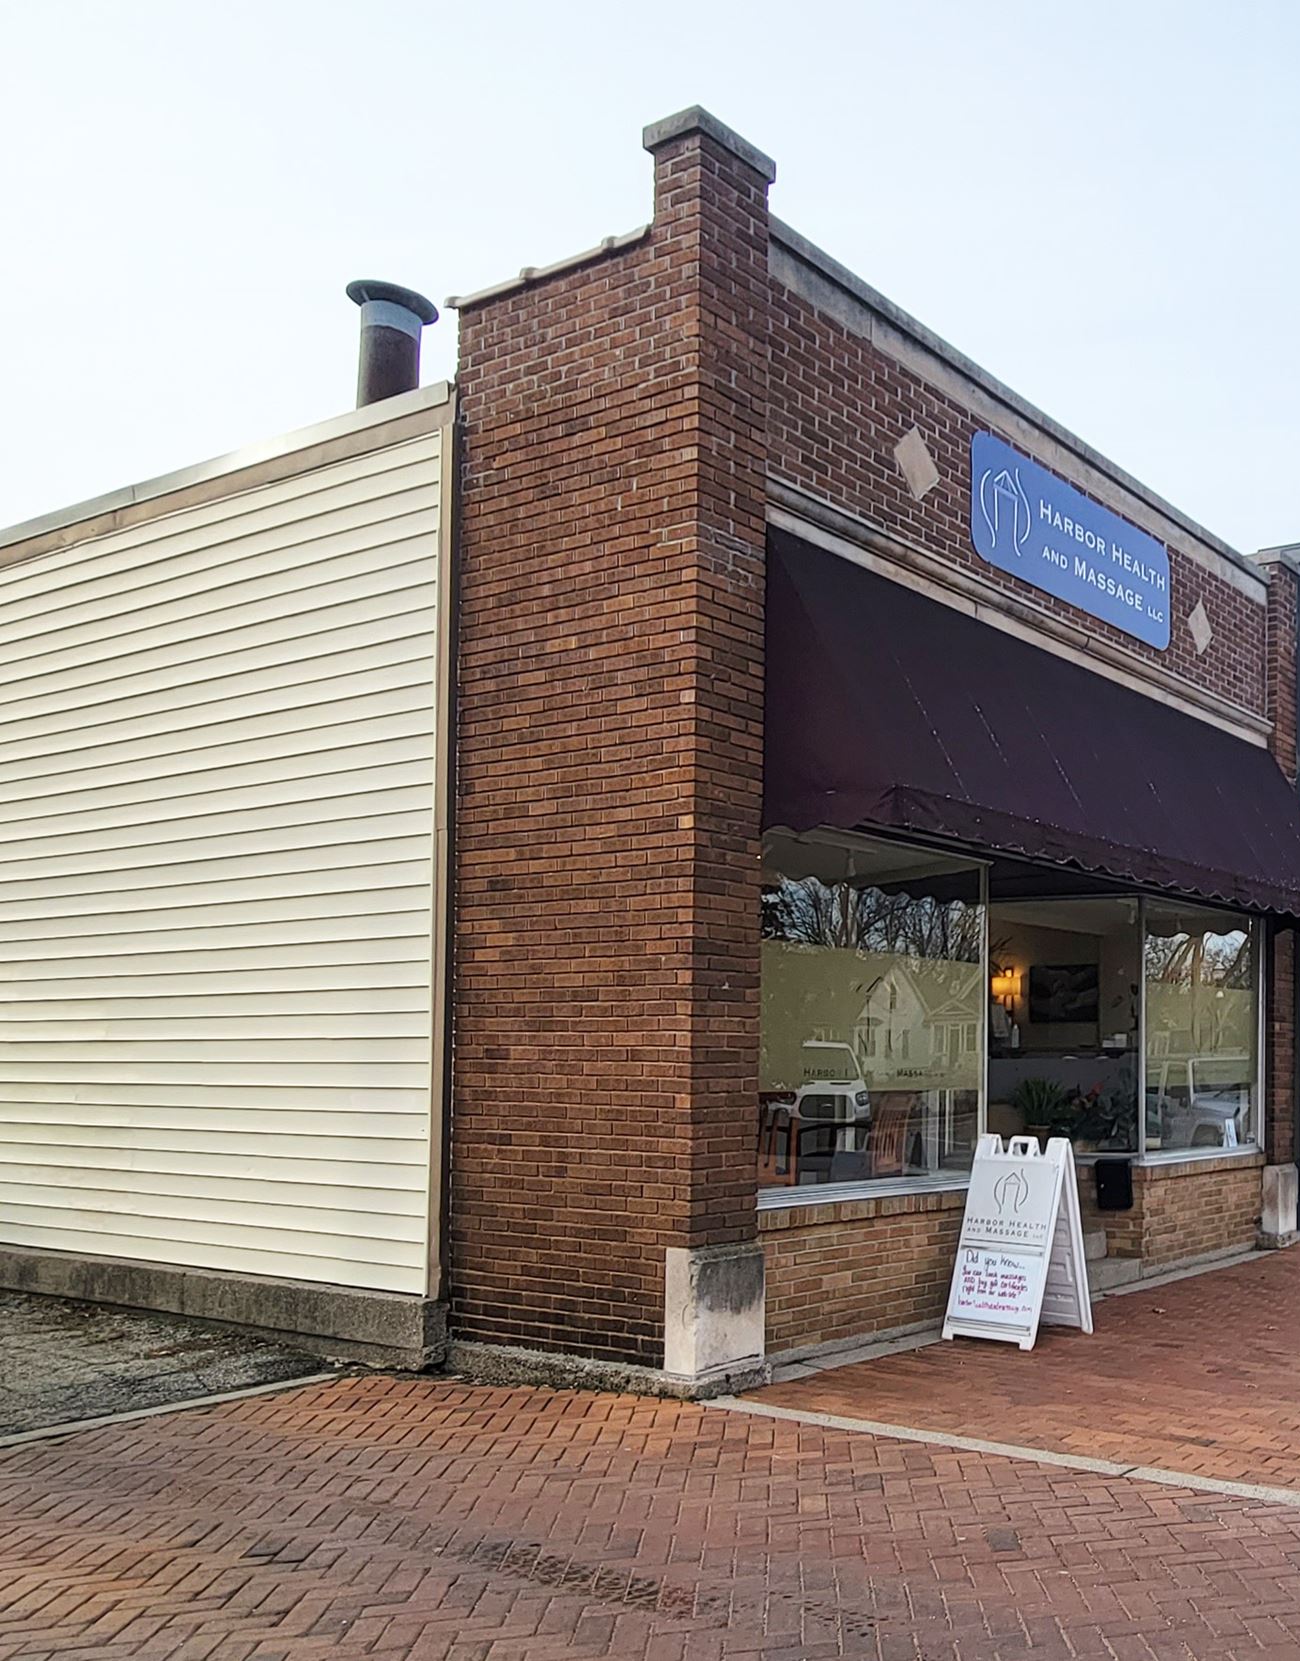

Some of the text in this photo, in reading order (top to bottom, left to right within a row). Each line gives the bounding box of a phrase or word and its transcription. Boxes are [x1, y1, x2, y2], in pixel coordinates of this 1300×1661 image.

[1039, 498, 1166, 592] HARBOR HEALTH
[1041, 546, 1164, 623] AND MASSAGE LLC
[967, 1217, 1047, 1231] HARBOR HEALTH
[985, 1226, 1029, 1238] MASSAGE
